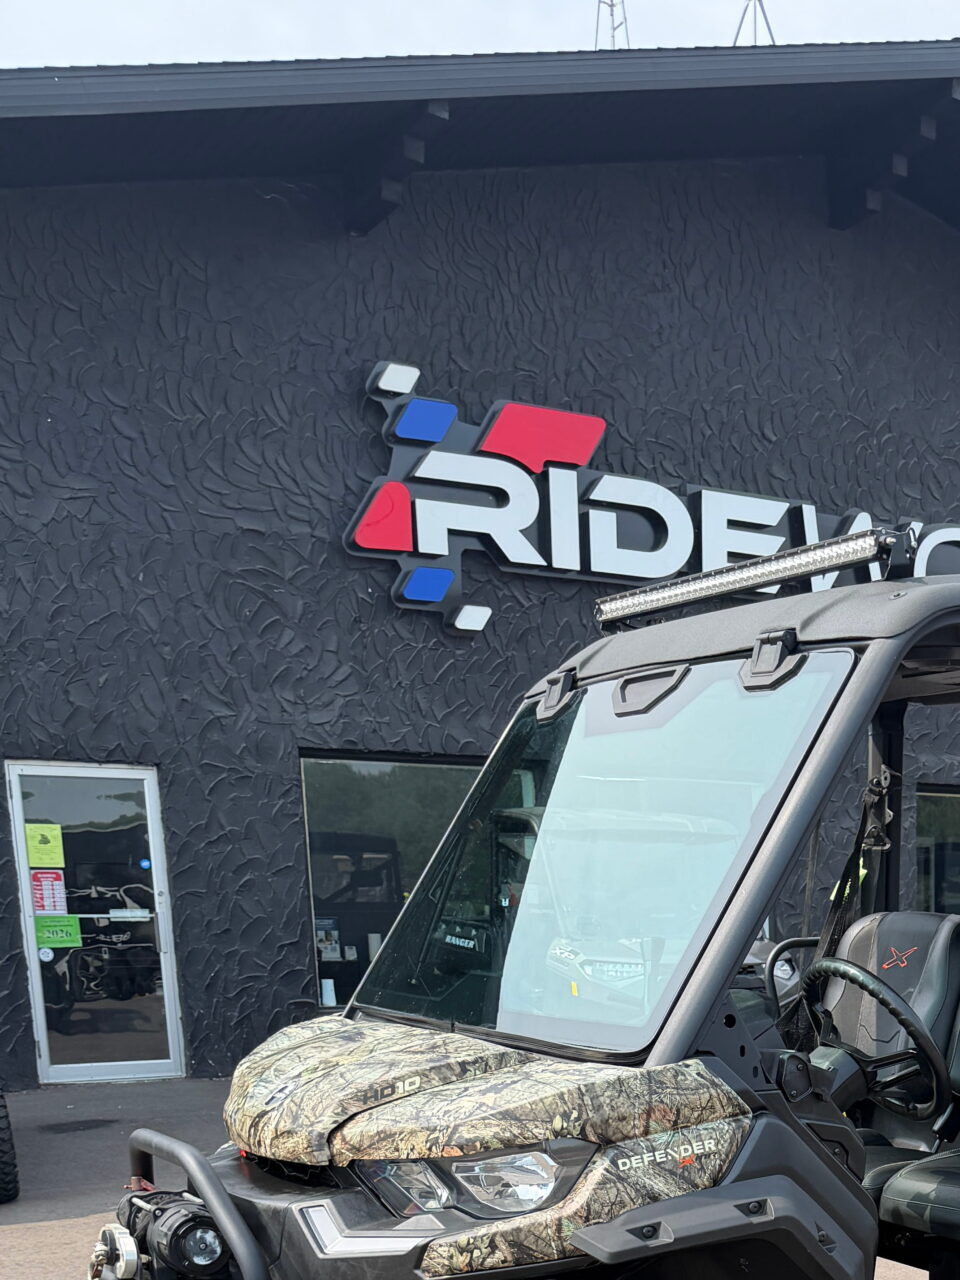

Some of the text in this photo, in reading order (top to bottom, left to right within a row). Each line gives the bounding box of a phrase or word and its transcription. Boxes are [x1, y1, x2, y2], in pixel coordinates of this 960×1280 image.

[445, 934, 475, 949] RANGER
[551, 946, 576, 960] XP
[362, 1075, 421, 1105] HD10
[617, 1139, 717, 1171] DEFENDER
